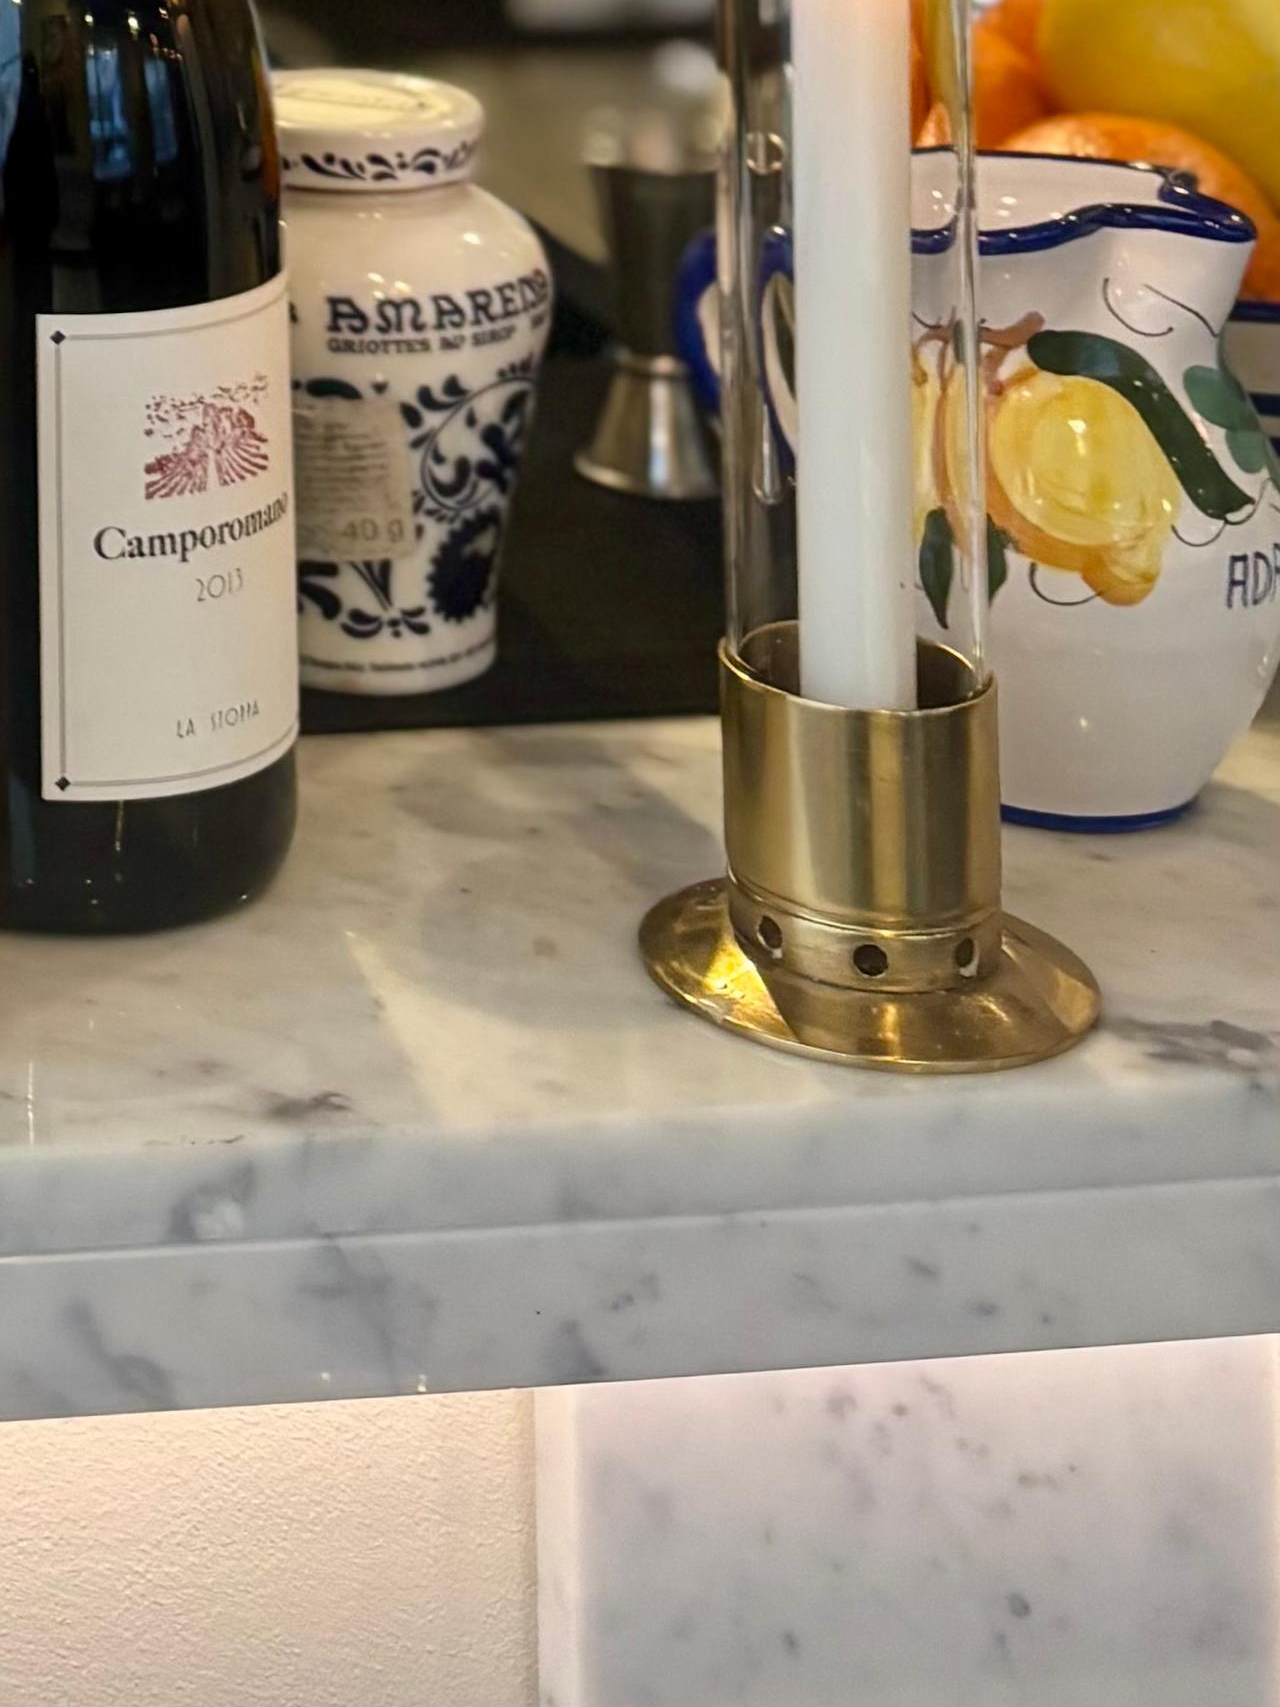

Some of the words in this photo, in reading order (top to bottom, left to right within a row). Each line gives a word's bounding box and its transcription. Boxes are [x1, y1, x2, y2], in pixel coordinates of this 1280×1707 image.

[326, 337, 433, 355] GRIOTTES
[93, 490, 290, 563] Camporomano
[195, 568, 244, 602] 2013
[176, 718, 196, 738] LA
